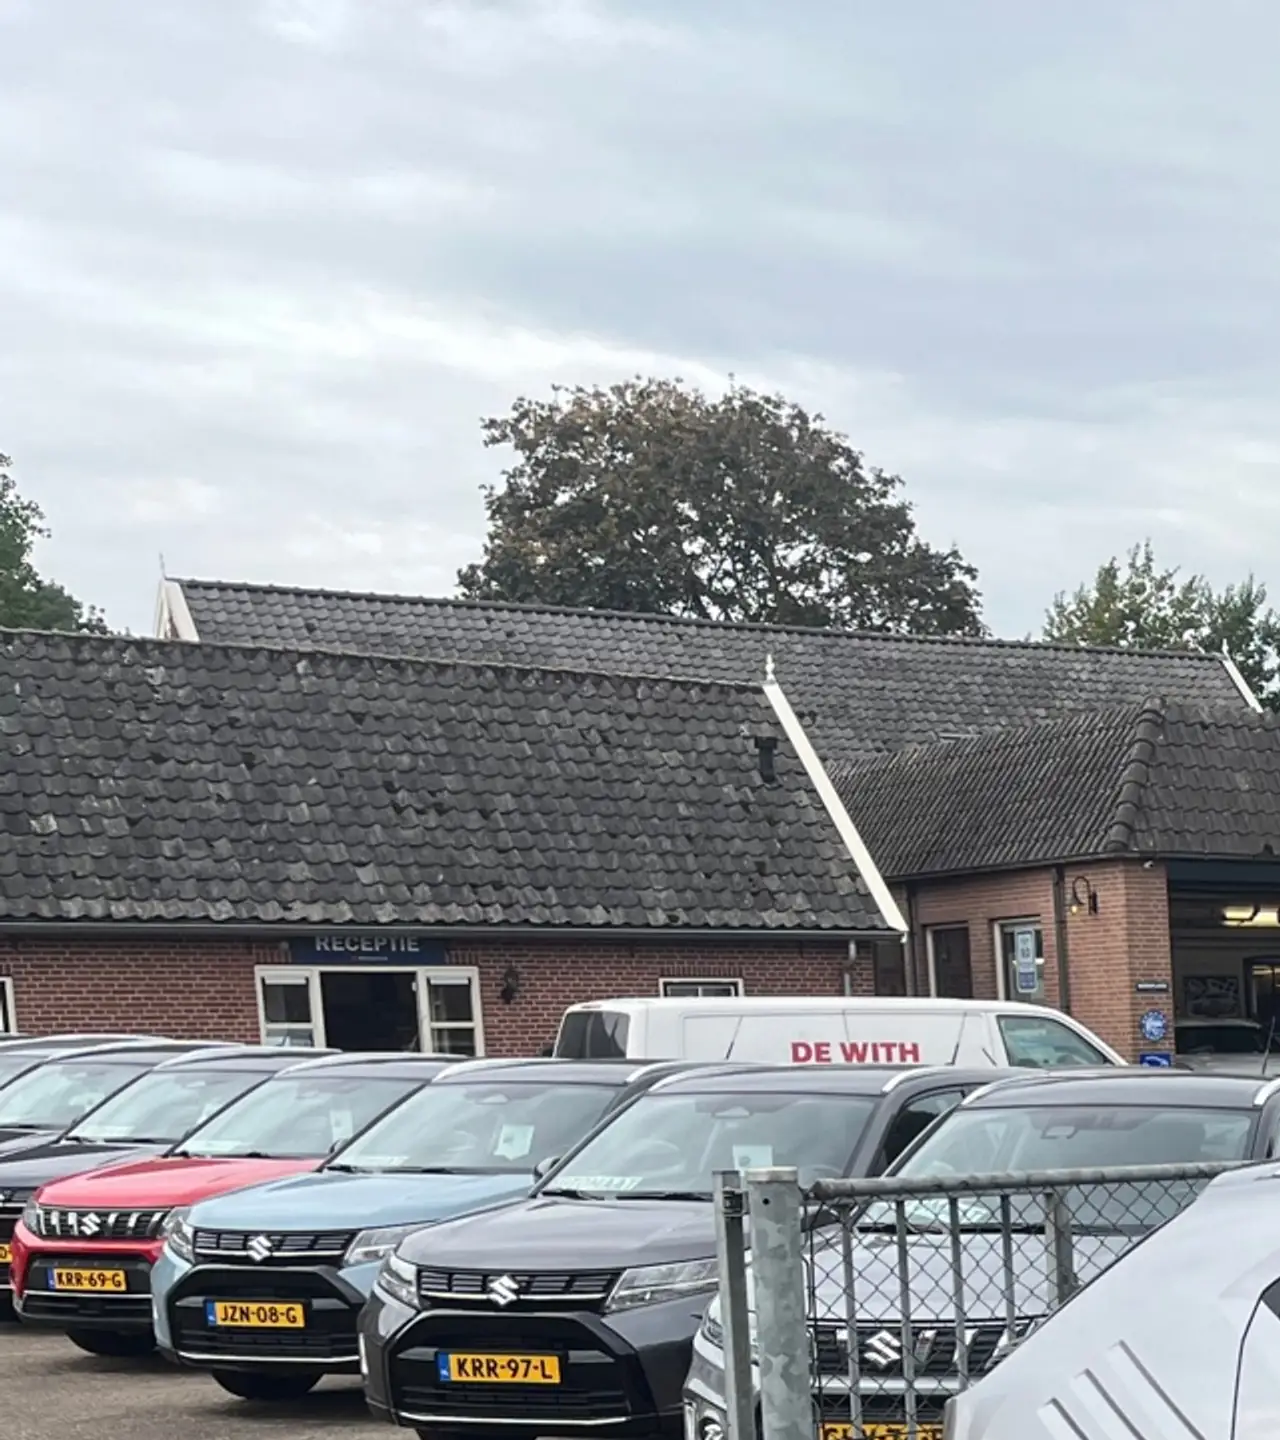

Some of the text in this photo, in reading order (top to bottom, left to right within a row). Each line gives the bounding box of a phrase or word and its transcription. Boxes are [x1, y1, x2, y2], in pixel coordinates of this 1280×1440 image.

[314, 935, 420, 952] RECEPTIE
[791, 1041, 920, 1063] DE WITH
[55, 1270, 123, 1288] KRR-69-G
[220, 1305, 298, 1324] JZN-08-G
[455, 1357, 553, 1379] KRR-97-L
